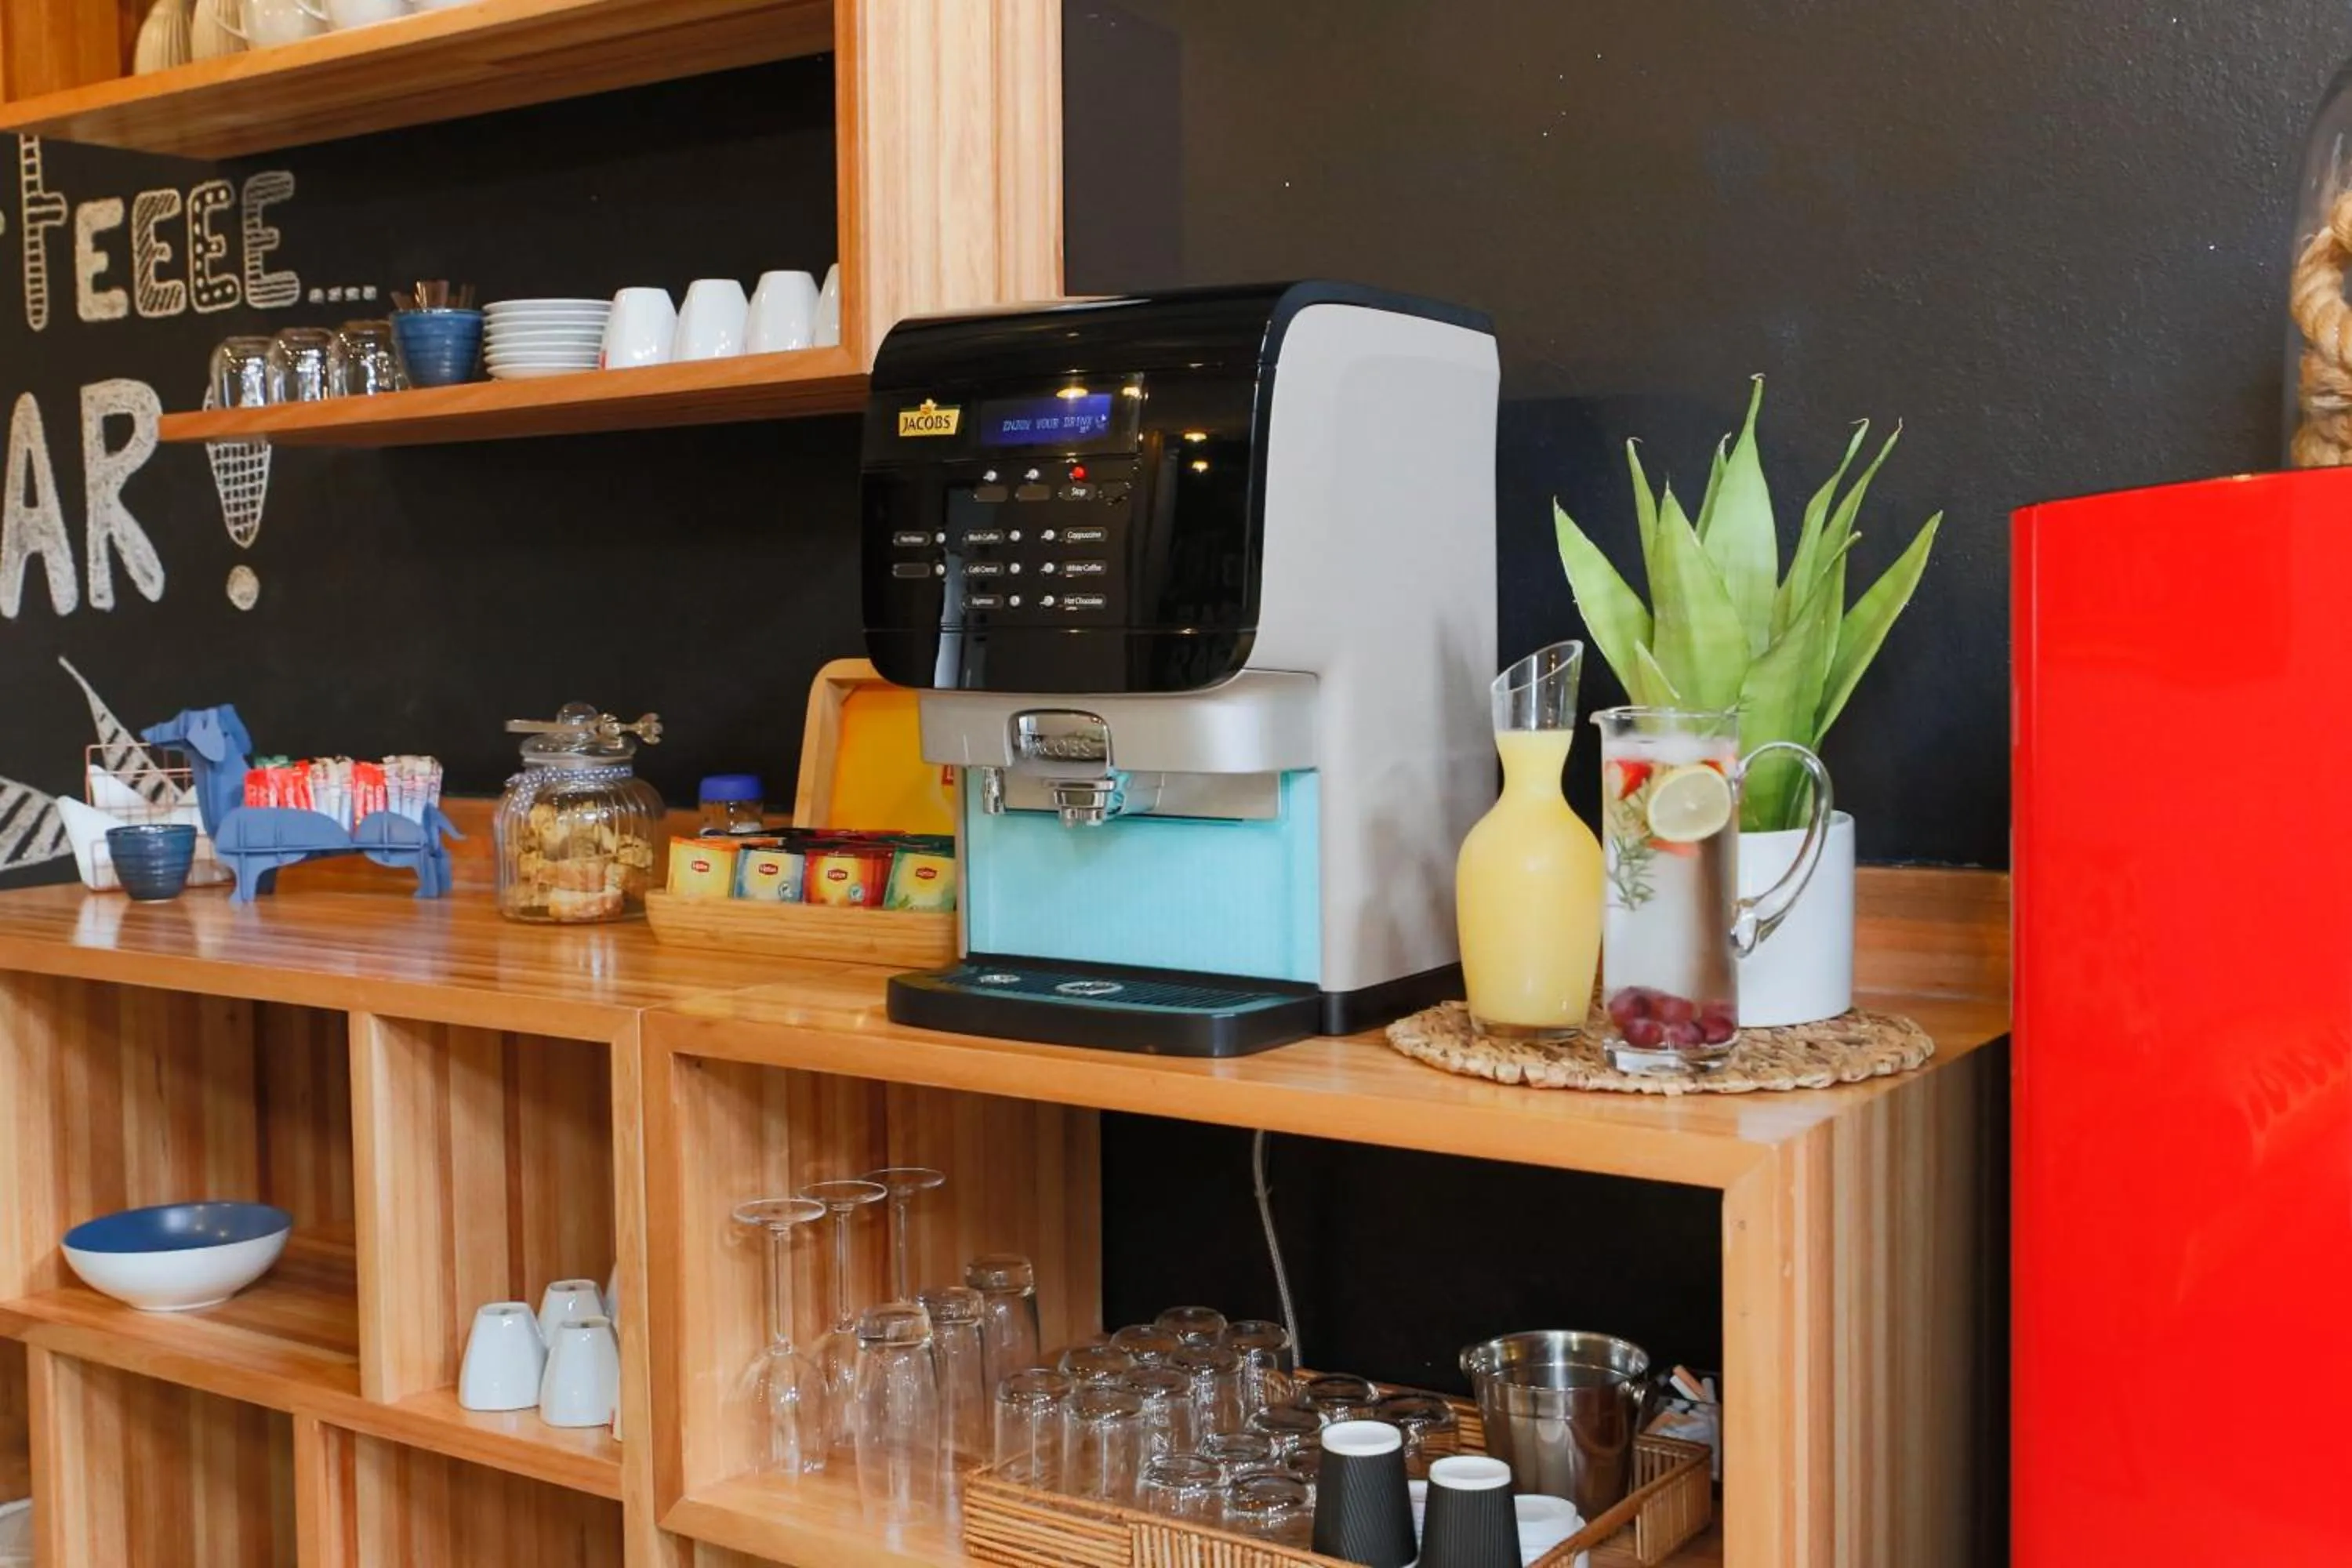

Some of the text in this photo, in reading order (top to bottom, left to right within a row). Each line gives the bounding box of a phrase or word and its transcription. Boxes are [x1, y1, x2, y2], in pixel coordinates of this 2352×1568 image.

[902, 415, 952, 434] JACOBS
[1003, 419, 1032, 432] ENJOY
[1036, 417, 1059, 430] YOUR
[1071, 487, 1087, 497] Stop
